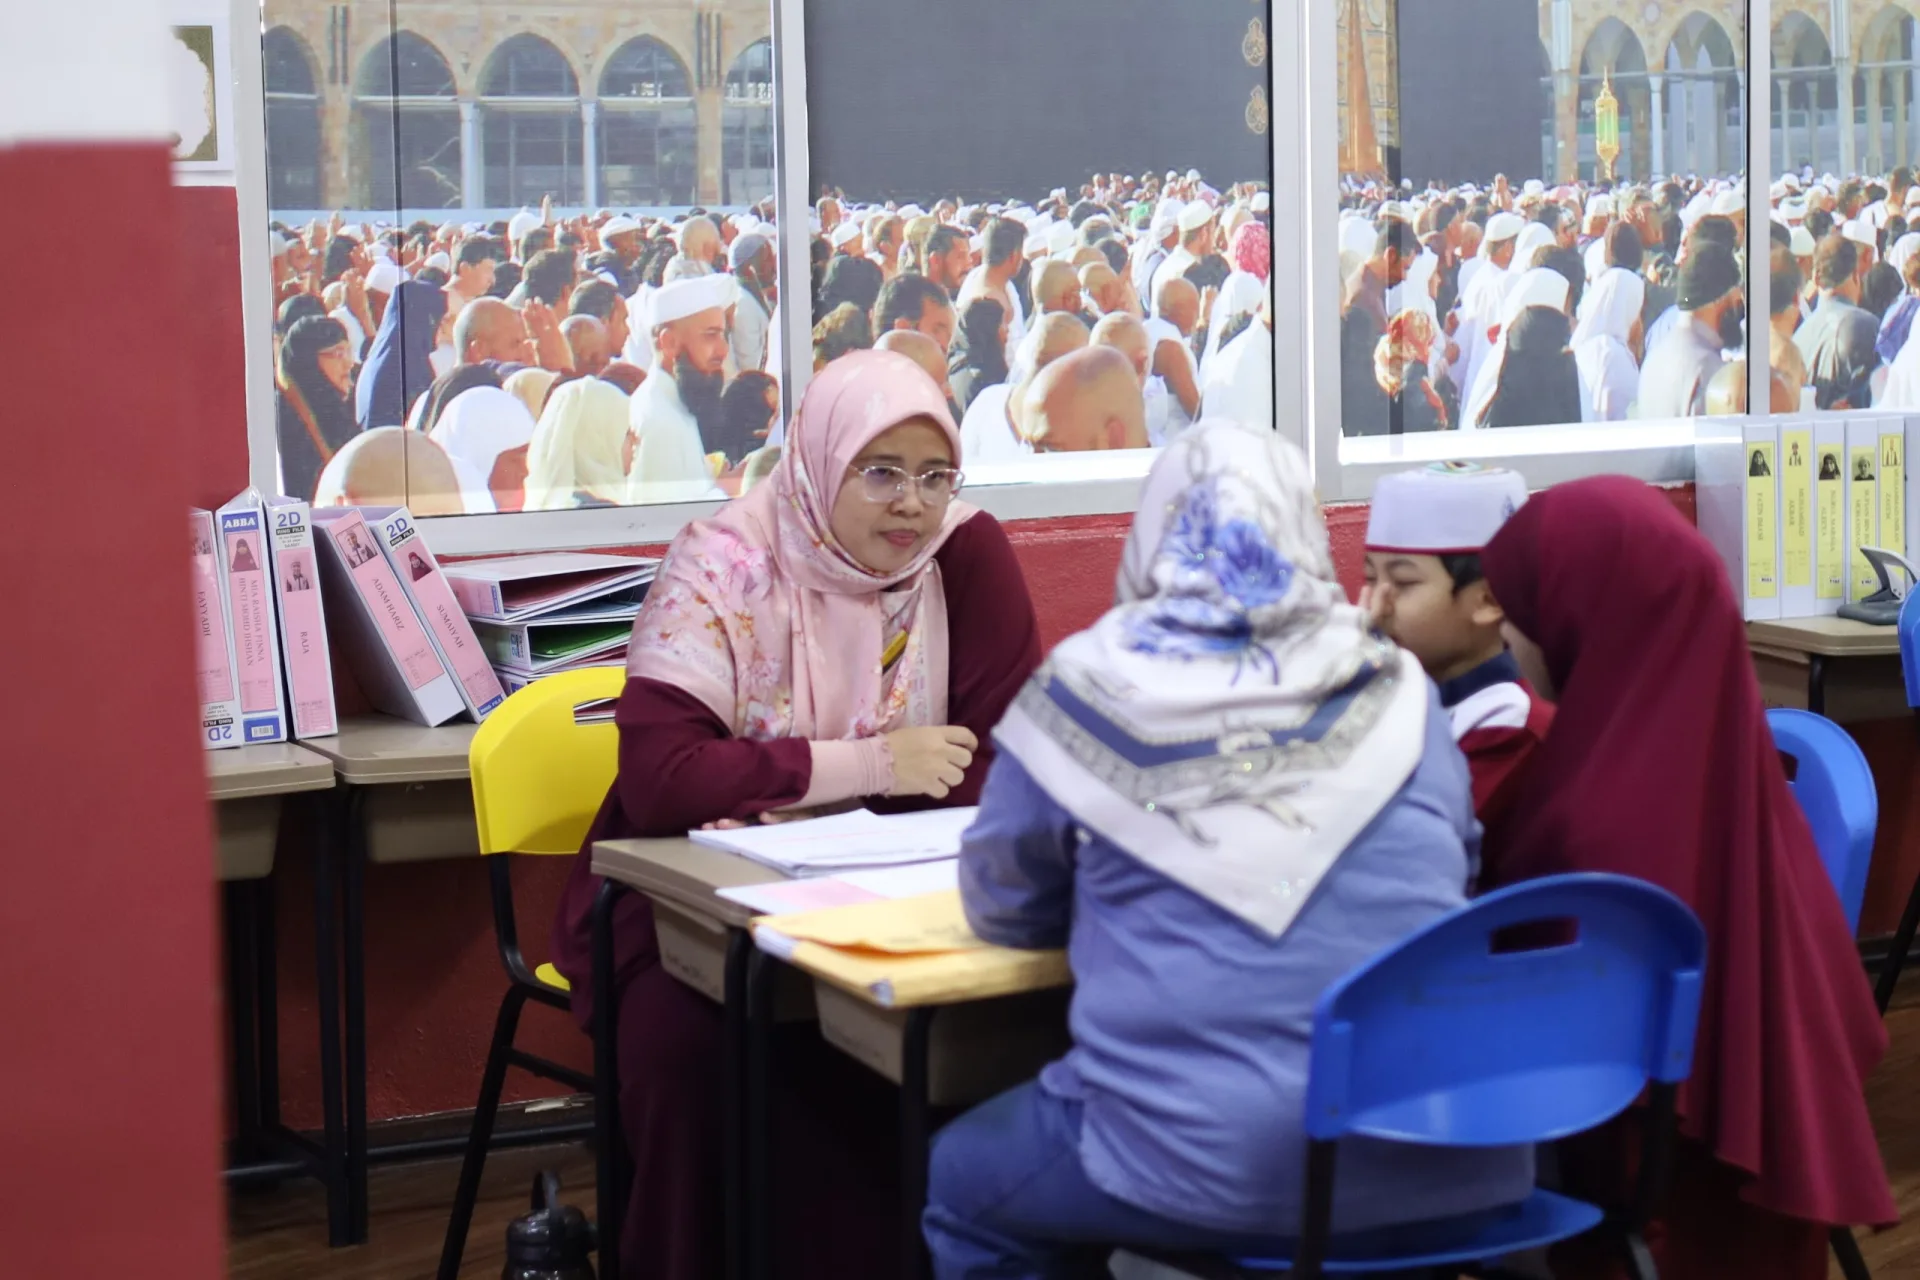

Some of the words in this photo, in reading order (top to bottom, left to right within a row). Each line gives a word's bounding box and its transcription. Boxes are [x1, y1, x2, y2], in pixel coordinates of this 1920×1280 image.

[224, 517, 256, 529] ABBA
[277, 511, 301, 527] 2D
[386, 517, 408, 538] 2D
[238, 577, 248, 602] BINTI
[250, 579, 259, 598] MIA
[197, 591, 212, 637] FAYYADH
[252, 599, 263, 633] RAISHA
[372, 577, 390, 604] ADAM
[387, 603, 405, 631] HARIZ
[241, 603, 251, 631] MOHD
[437, 603, 464, 648] SUMAIYAH
[300, 631, 310, 655] RAJA
[208, 725, 232, 742] 2D
